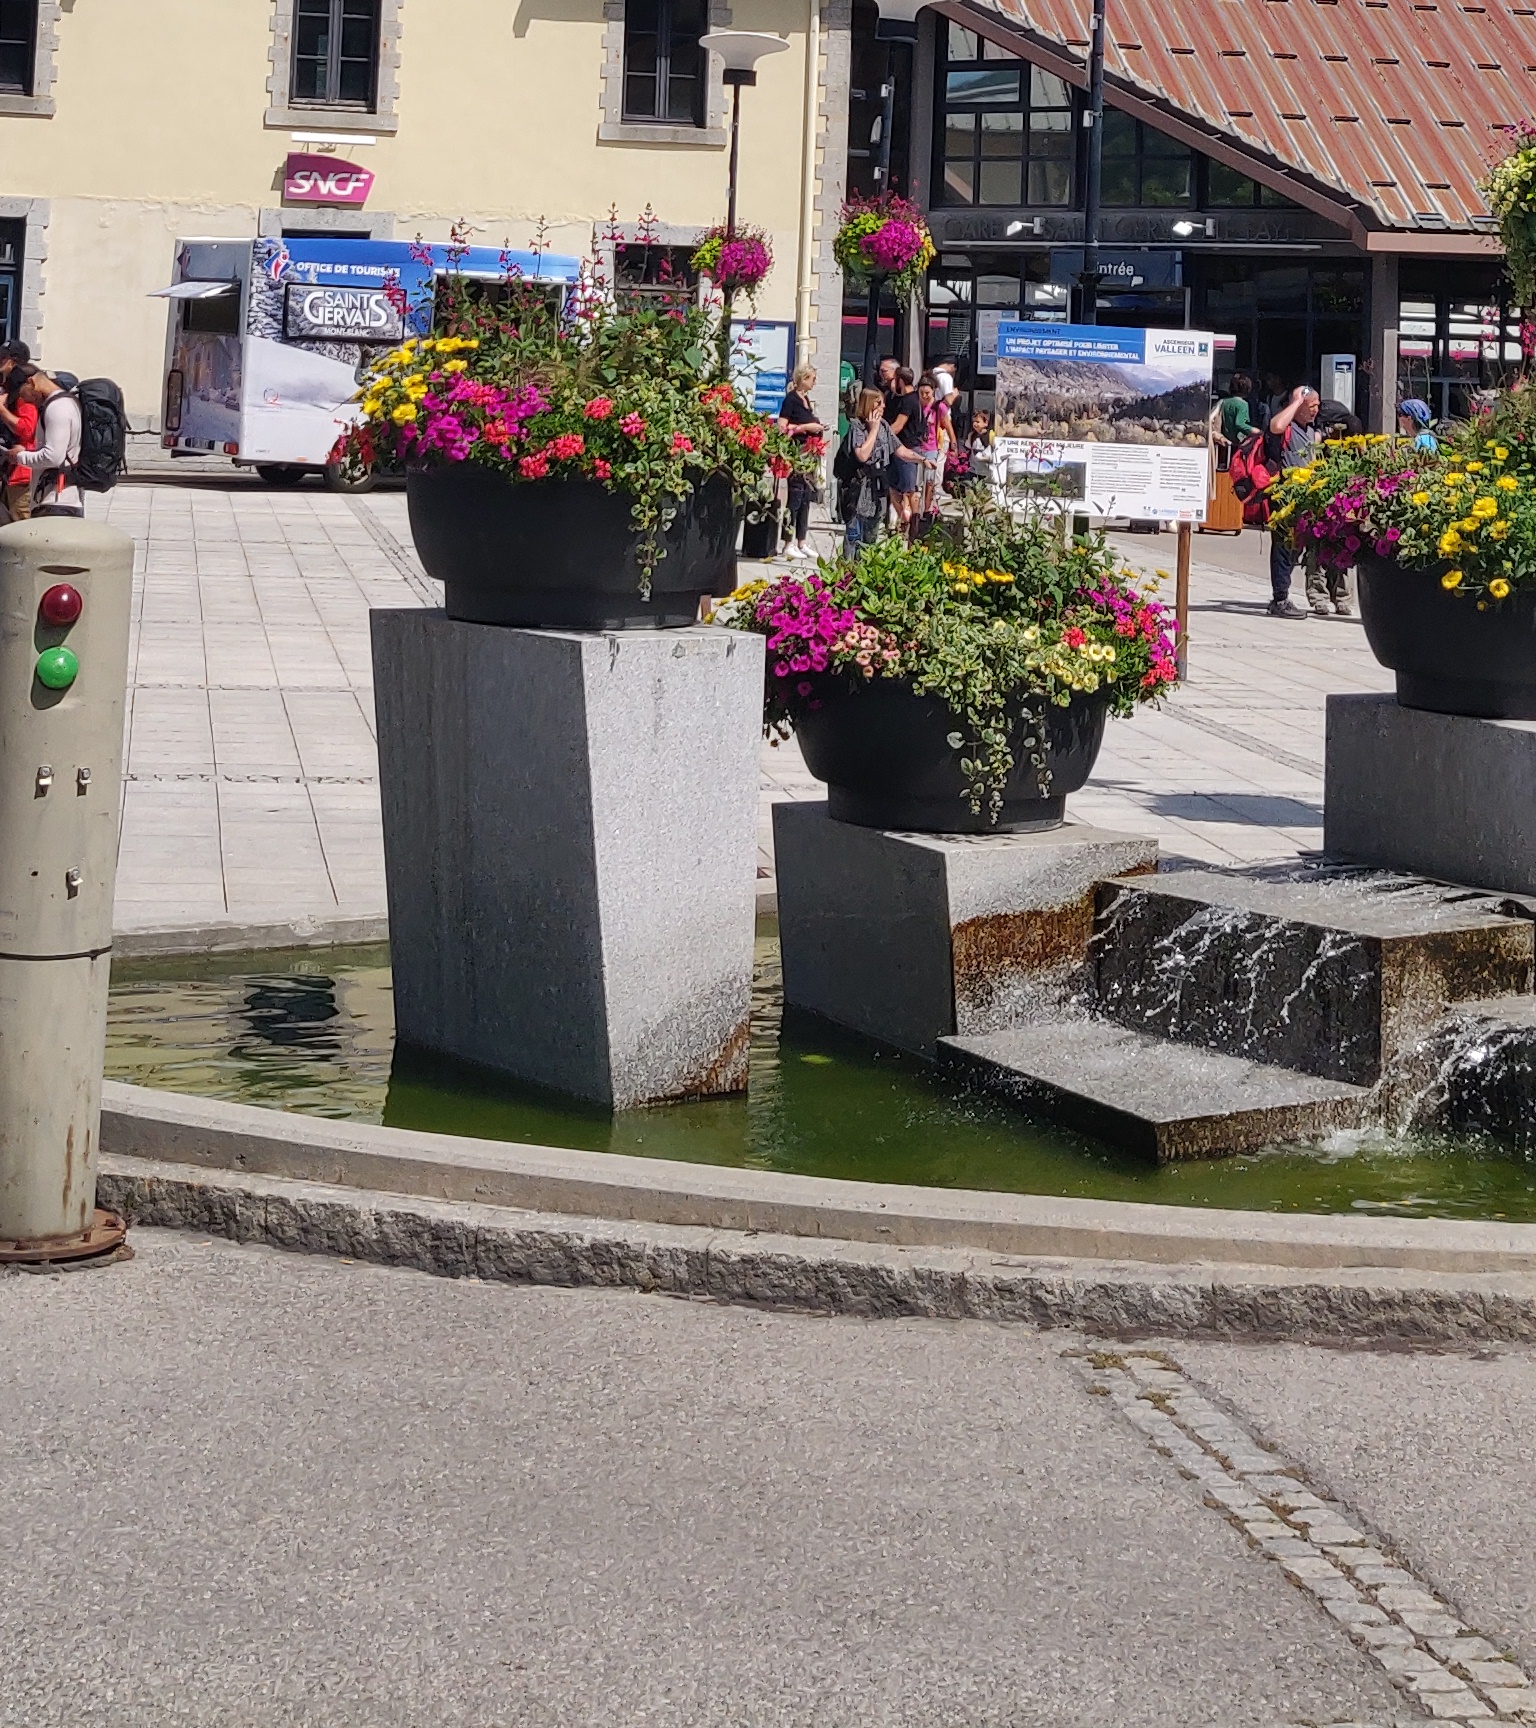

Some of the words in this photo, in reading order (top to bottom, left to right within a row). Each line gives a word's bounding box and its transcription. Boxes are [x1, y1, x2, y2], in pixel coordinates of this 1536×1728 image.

[288, 170, 370, 196] SNCF
[296, 262, 333, 273] OFFICE
[334, 264, 349, 274] DE
[1096, 261, 1134, 276] ntrée
[324, 291, 371, 308] SAINT
[303, 291, 388, 328] GERVAIS
